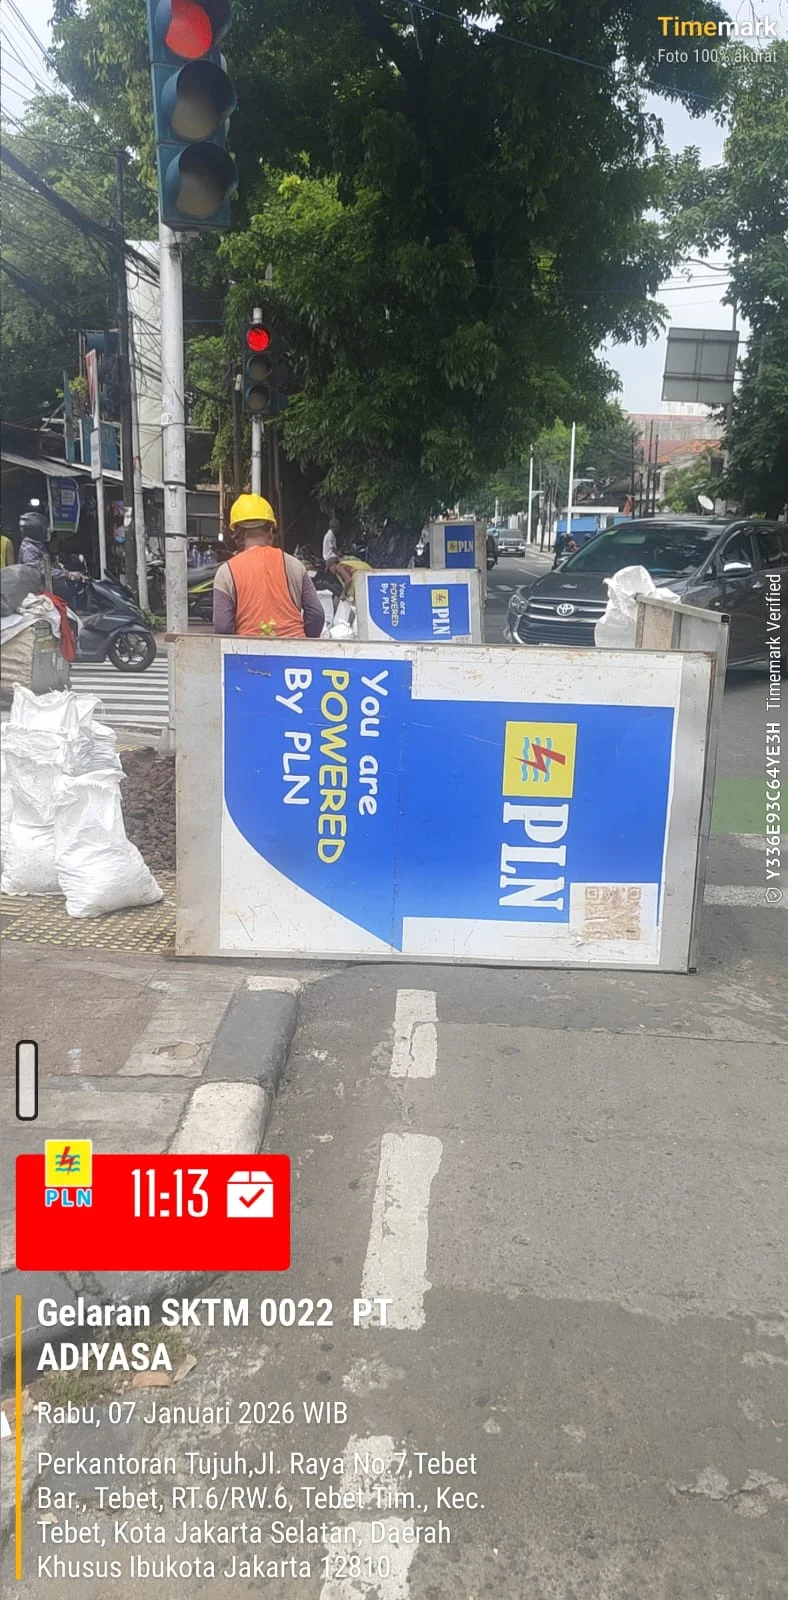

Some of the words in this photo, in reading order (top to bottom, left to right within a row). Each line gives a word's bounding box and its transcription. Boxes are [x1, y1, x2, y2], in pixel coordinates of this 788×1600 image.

[458, 541, 474, 552] PLN
[380, 583, 389, 594] By
[390, 582, 399, 628] POWERED
[432, 608, 450, 635] PLN
[275, 668, 313, 714] By
[360, 670, 388, 737] You
[282, 731, 312, 806] PLN
[317, 669, 350, 864] POWERED
[358, 755, 378, 816] are
[499, 803, 569, 910] PLN
